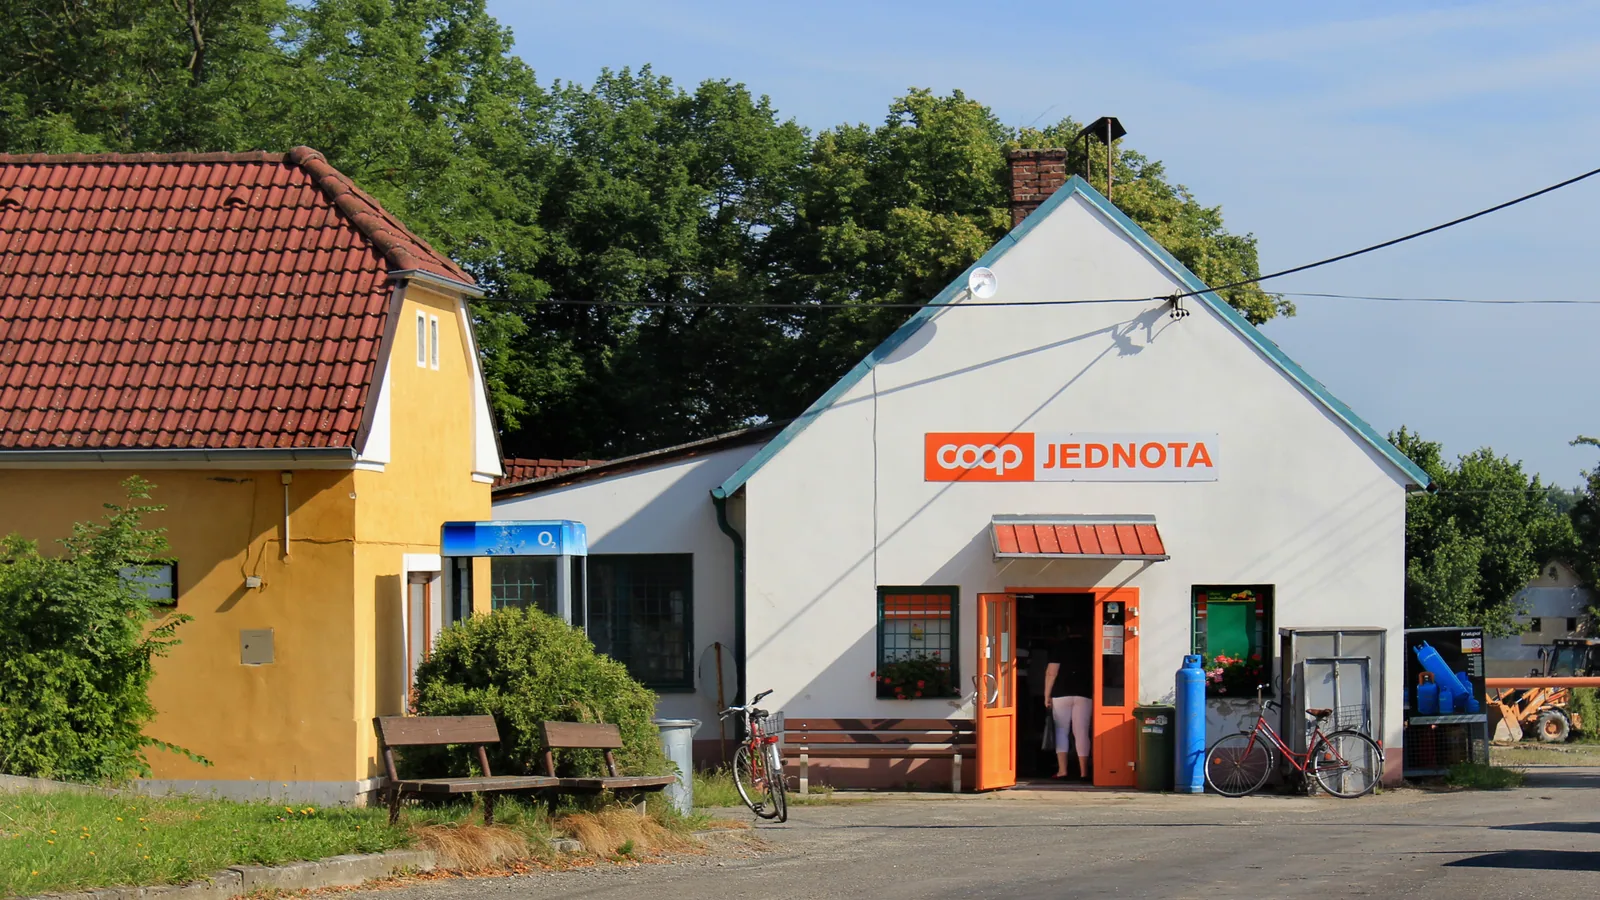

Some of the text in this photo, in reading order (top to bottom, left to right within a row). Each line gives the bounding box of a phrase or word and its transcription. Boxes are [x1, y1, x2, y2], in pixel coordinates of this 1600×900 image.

[936, 442, 1213, 475] coop JEDNOTA
[538, 531, 556, 549] O2
